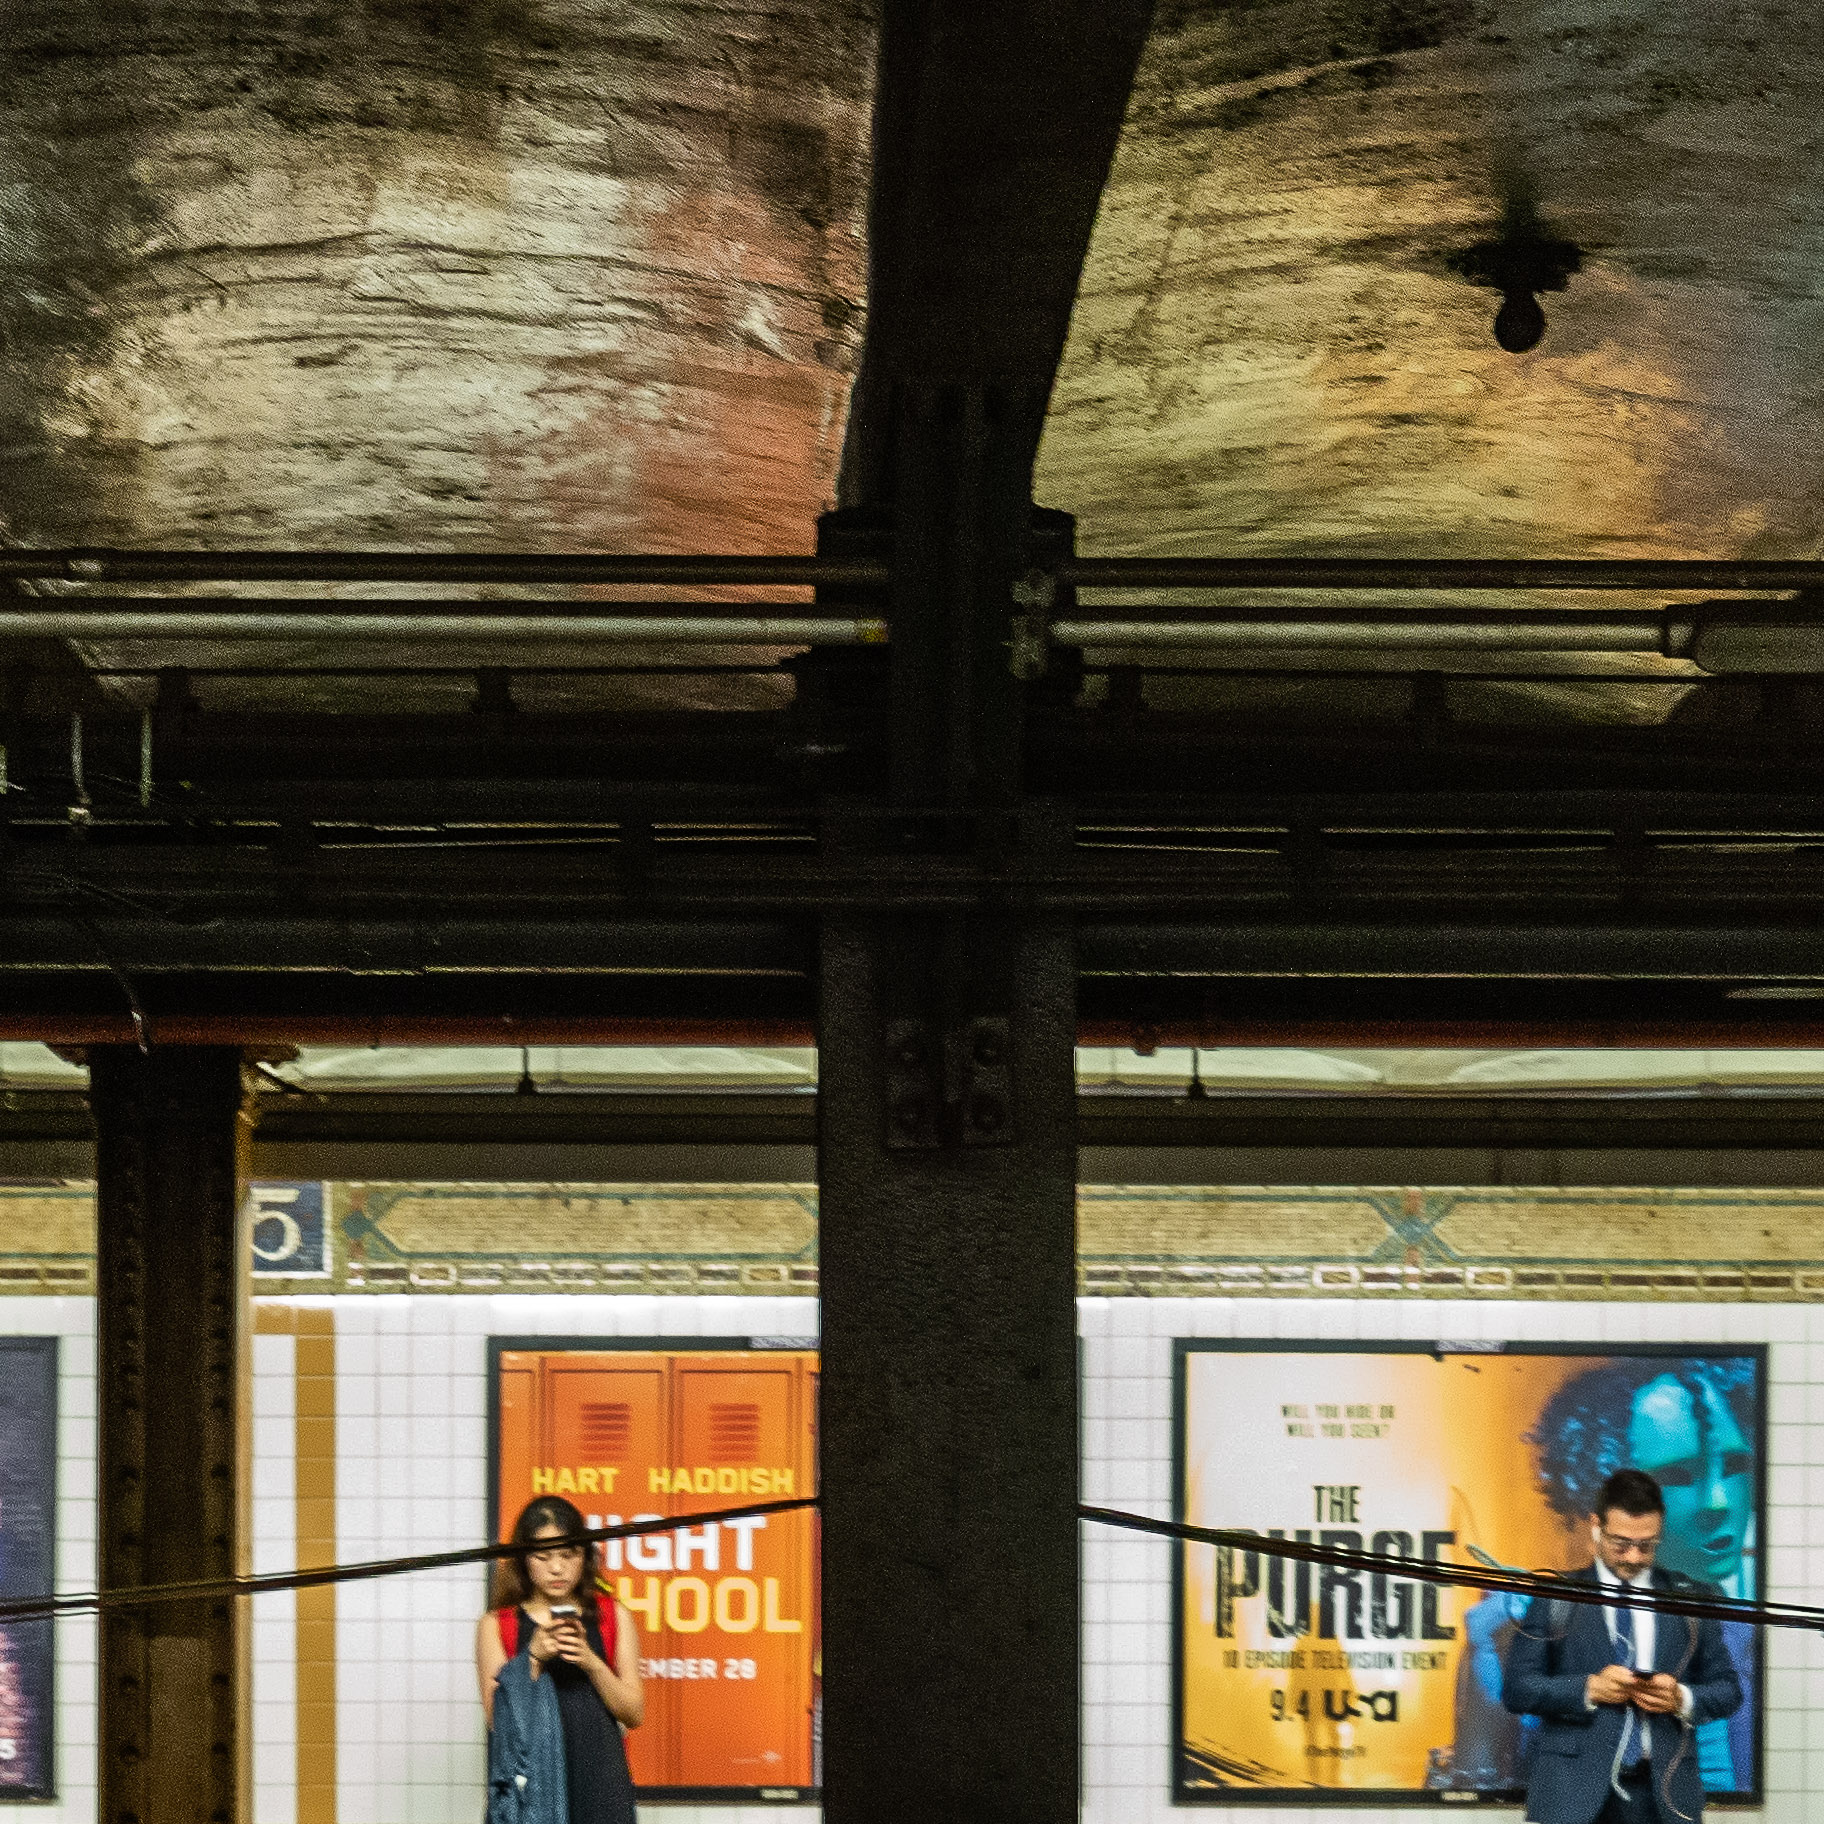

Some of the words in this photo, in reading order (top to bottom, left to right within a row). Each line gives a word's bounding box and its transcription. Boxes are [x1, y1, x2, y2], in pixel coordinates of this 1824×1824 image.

[250, 1188, 302, 1262] 5
[532, 1466, 620, 1494] HART
[648, 1466, 795, 1494] HADDISH
[1313, 1485, 1360, 1523] THE
[585, 1513, 768, 1571] IGHT
[1215, 1529, 1457, 1640] PURGE
[723, 1657, 757, 1680] 28
[1244, 1650, 1306, 1669] EPISODE
[1311, 1650, 1396, 1670] TELEVISION
[1401, 1651, 1447, 1670] EVENT
